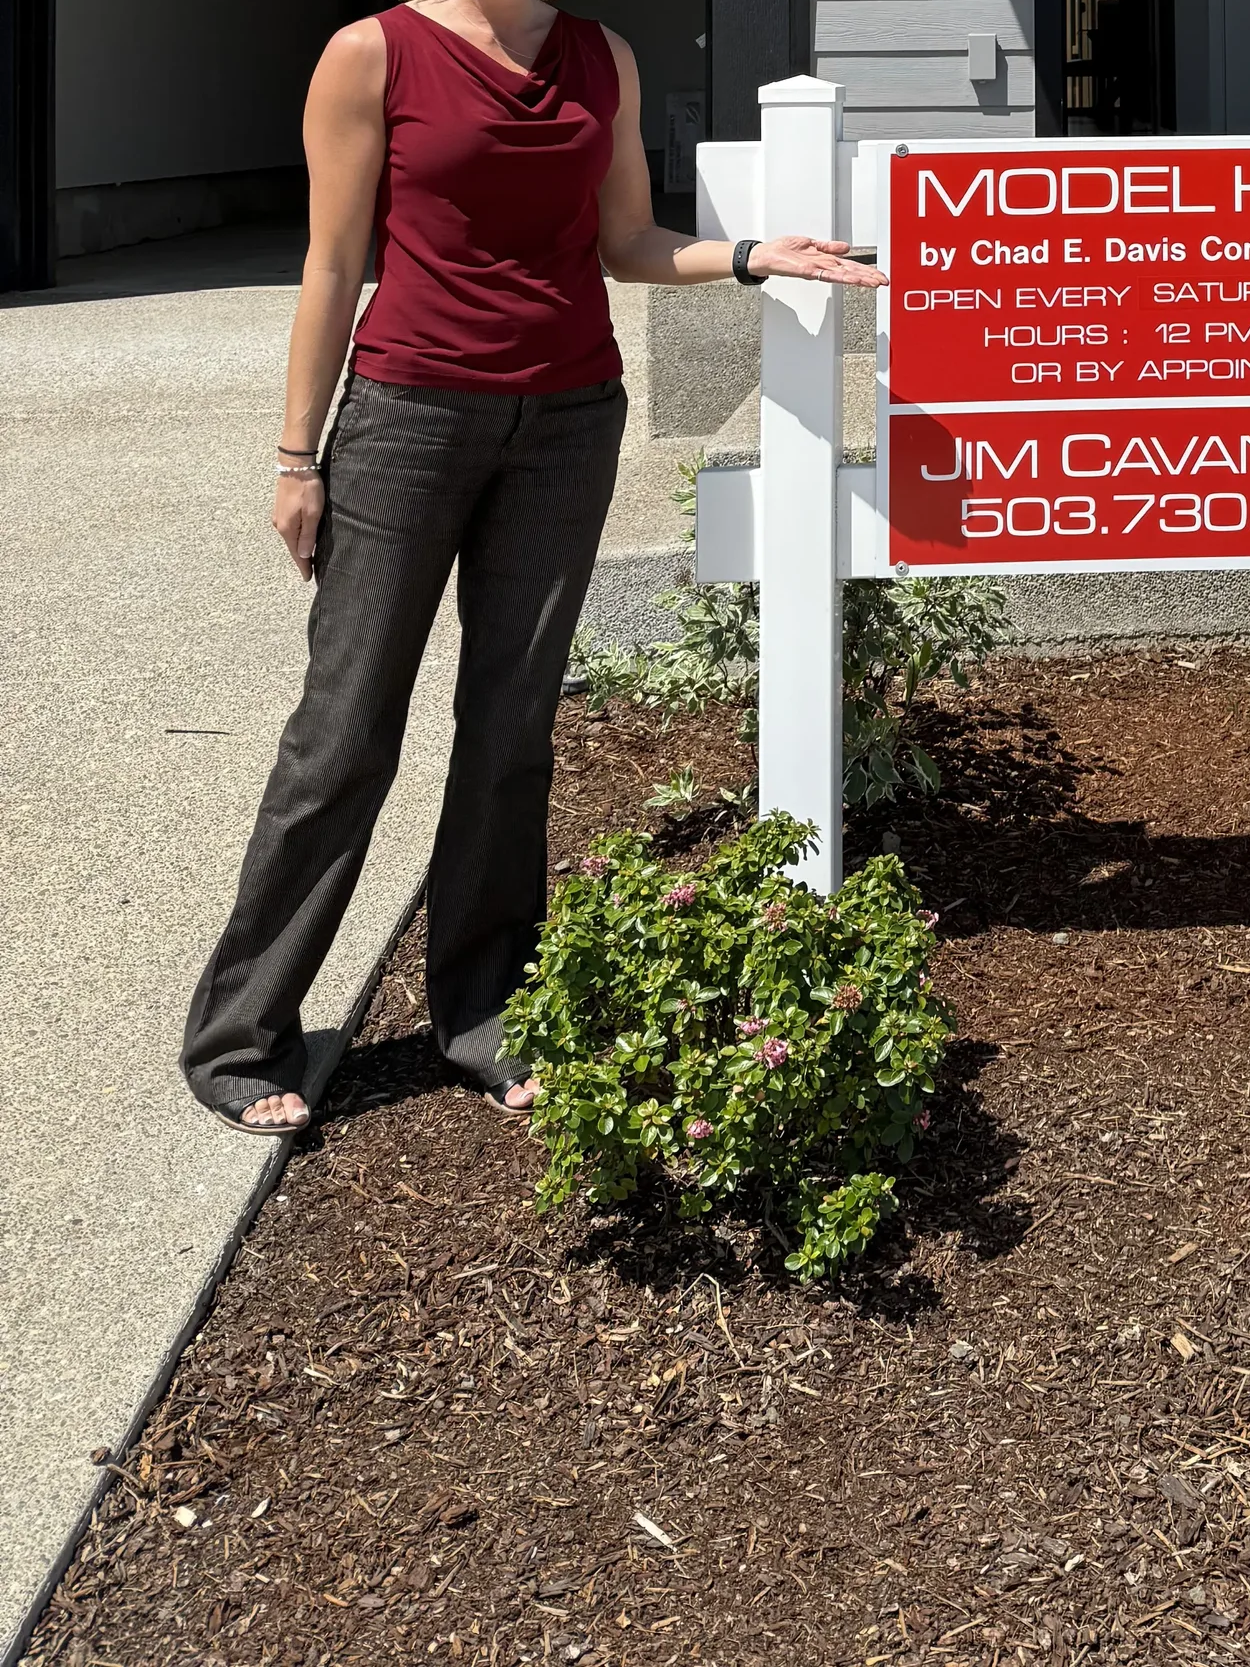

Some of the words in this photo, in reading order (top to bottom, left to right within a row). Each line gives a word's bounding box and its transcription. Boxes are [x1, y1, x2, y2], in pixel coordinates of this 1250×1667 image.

[917, 165, 1216, 218] MODEL
[920, 241, 957, 271] by
[970, 239, 1049, 266] Chad
[1063, 238, 1091, 263] E.
[1105, 236, 1187, 263] Davis
[903, 288, 1002, 311] OPEN
[1015, 285, 1132, 309] EVERY
[1154, 322, 1191, 344] 12
[1011, 362, 1062, 384] OR
[1076, 360, 1125, 382] BY
[920, 436, 1039, 482] JIM
